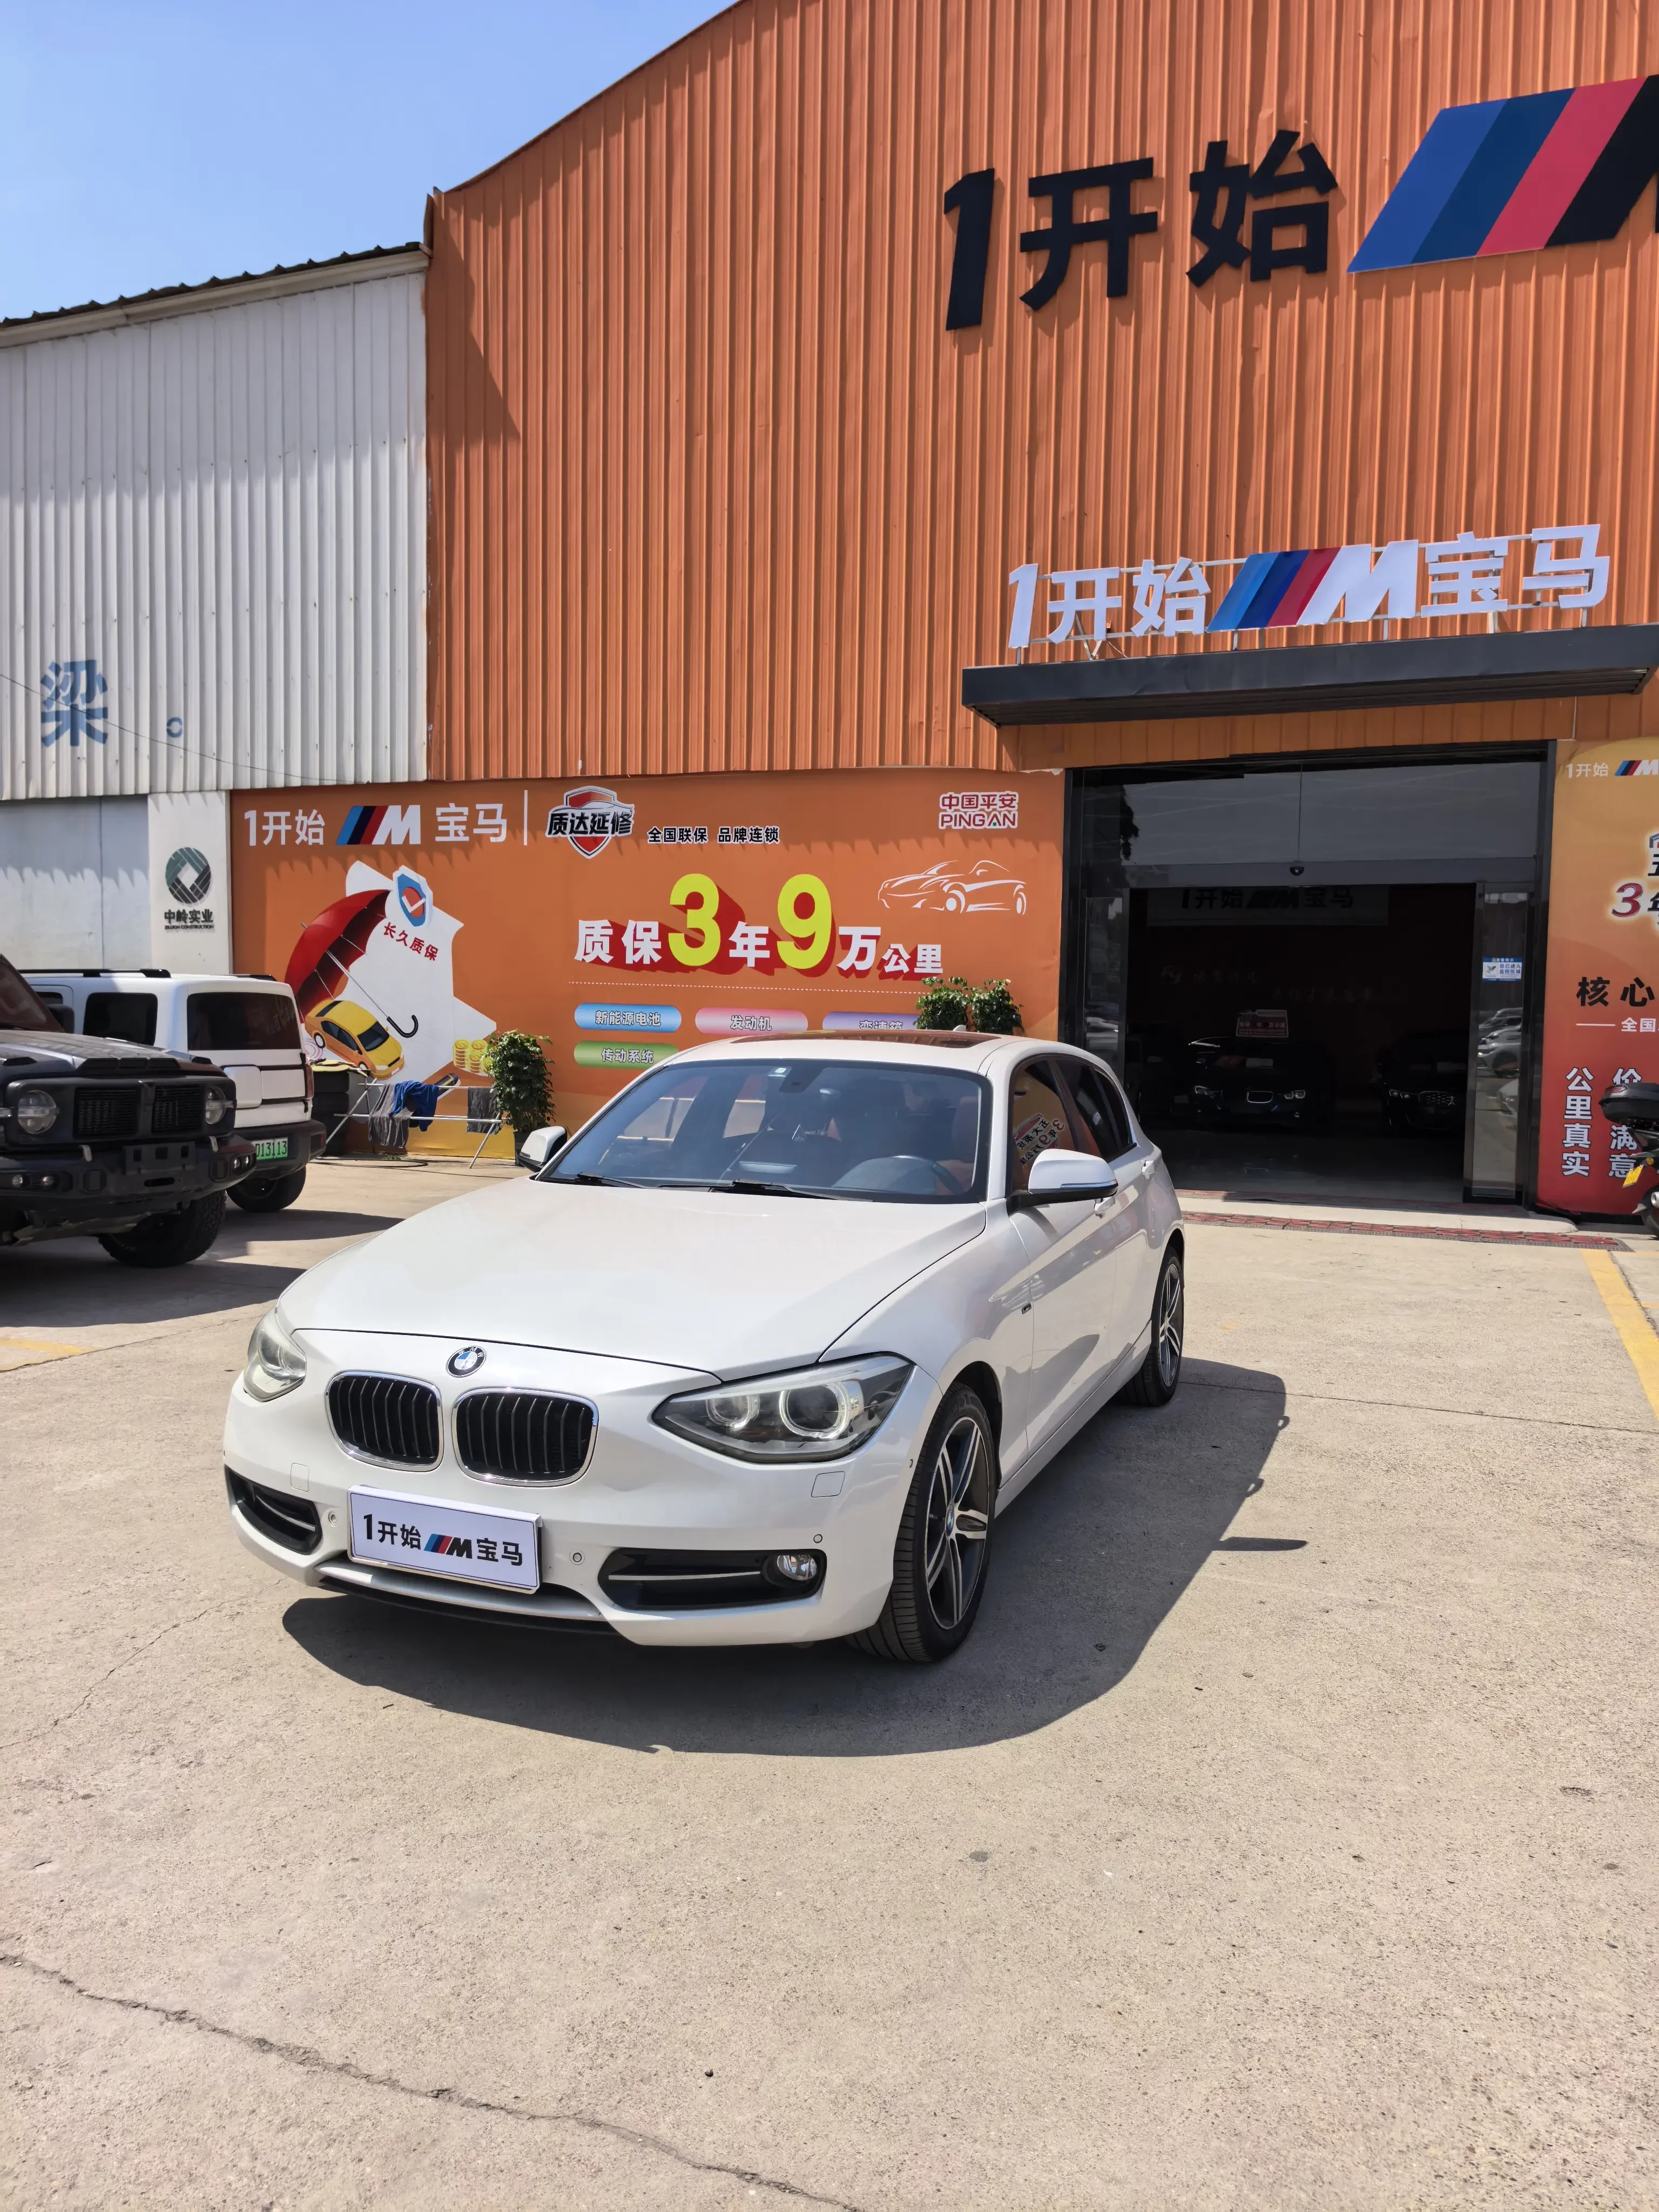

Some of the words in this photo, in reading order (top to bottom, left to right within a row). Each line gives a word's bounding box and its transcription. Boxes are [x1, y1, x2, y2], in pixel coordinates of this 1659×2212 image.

[944, 130, 1337, 331] 1开始
[1421, 523, 1610, 617] 宝马
[1567, 762, 1609, 778] 1开始
[941, 793, 1016, 810] 中国平安
[244, 809, 325, 846] 1开始
[435, 803, 508, 843] 宝马
[548, 812, 633, 835] 质达延修
[648, 827, 708, 843] 全国联保
[717, 827, 779, 843] 品牌连锁
[383, 922, 439, 961] 长久质保
[1576, 976, 1655, 1007] 核心
[595, 1010, 661, 1027] 新能源电池
[730, 1015, 772, 1031] 发动机
[1621, 1017, 1659, 1033] 全国
[601, 1047, 654, 1064] 传动系统
[1562, 1067, 1594, 1177] 公里真实
[1609, 1068, 1643, 1179] 价满意
[363, 1514, 421, 1550] 1开始
[476, 1538, 523, 1566] 宝马
